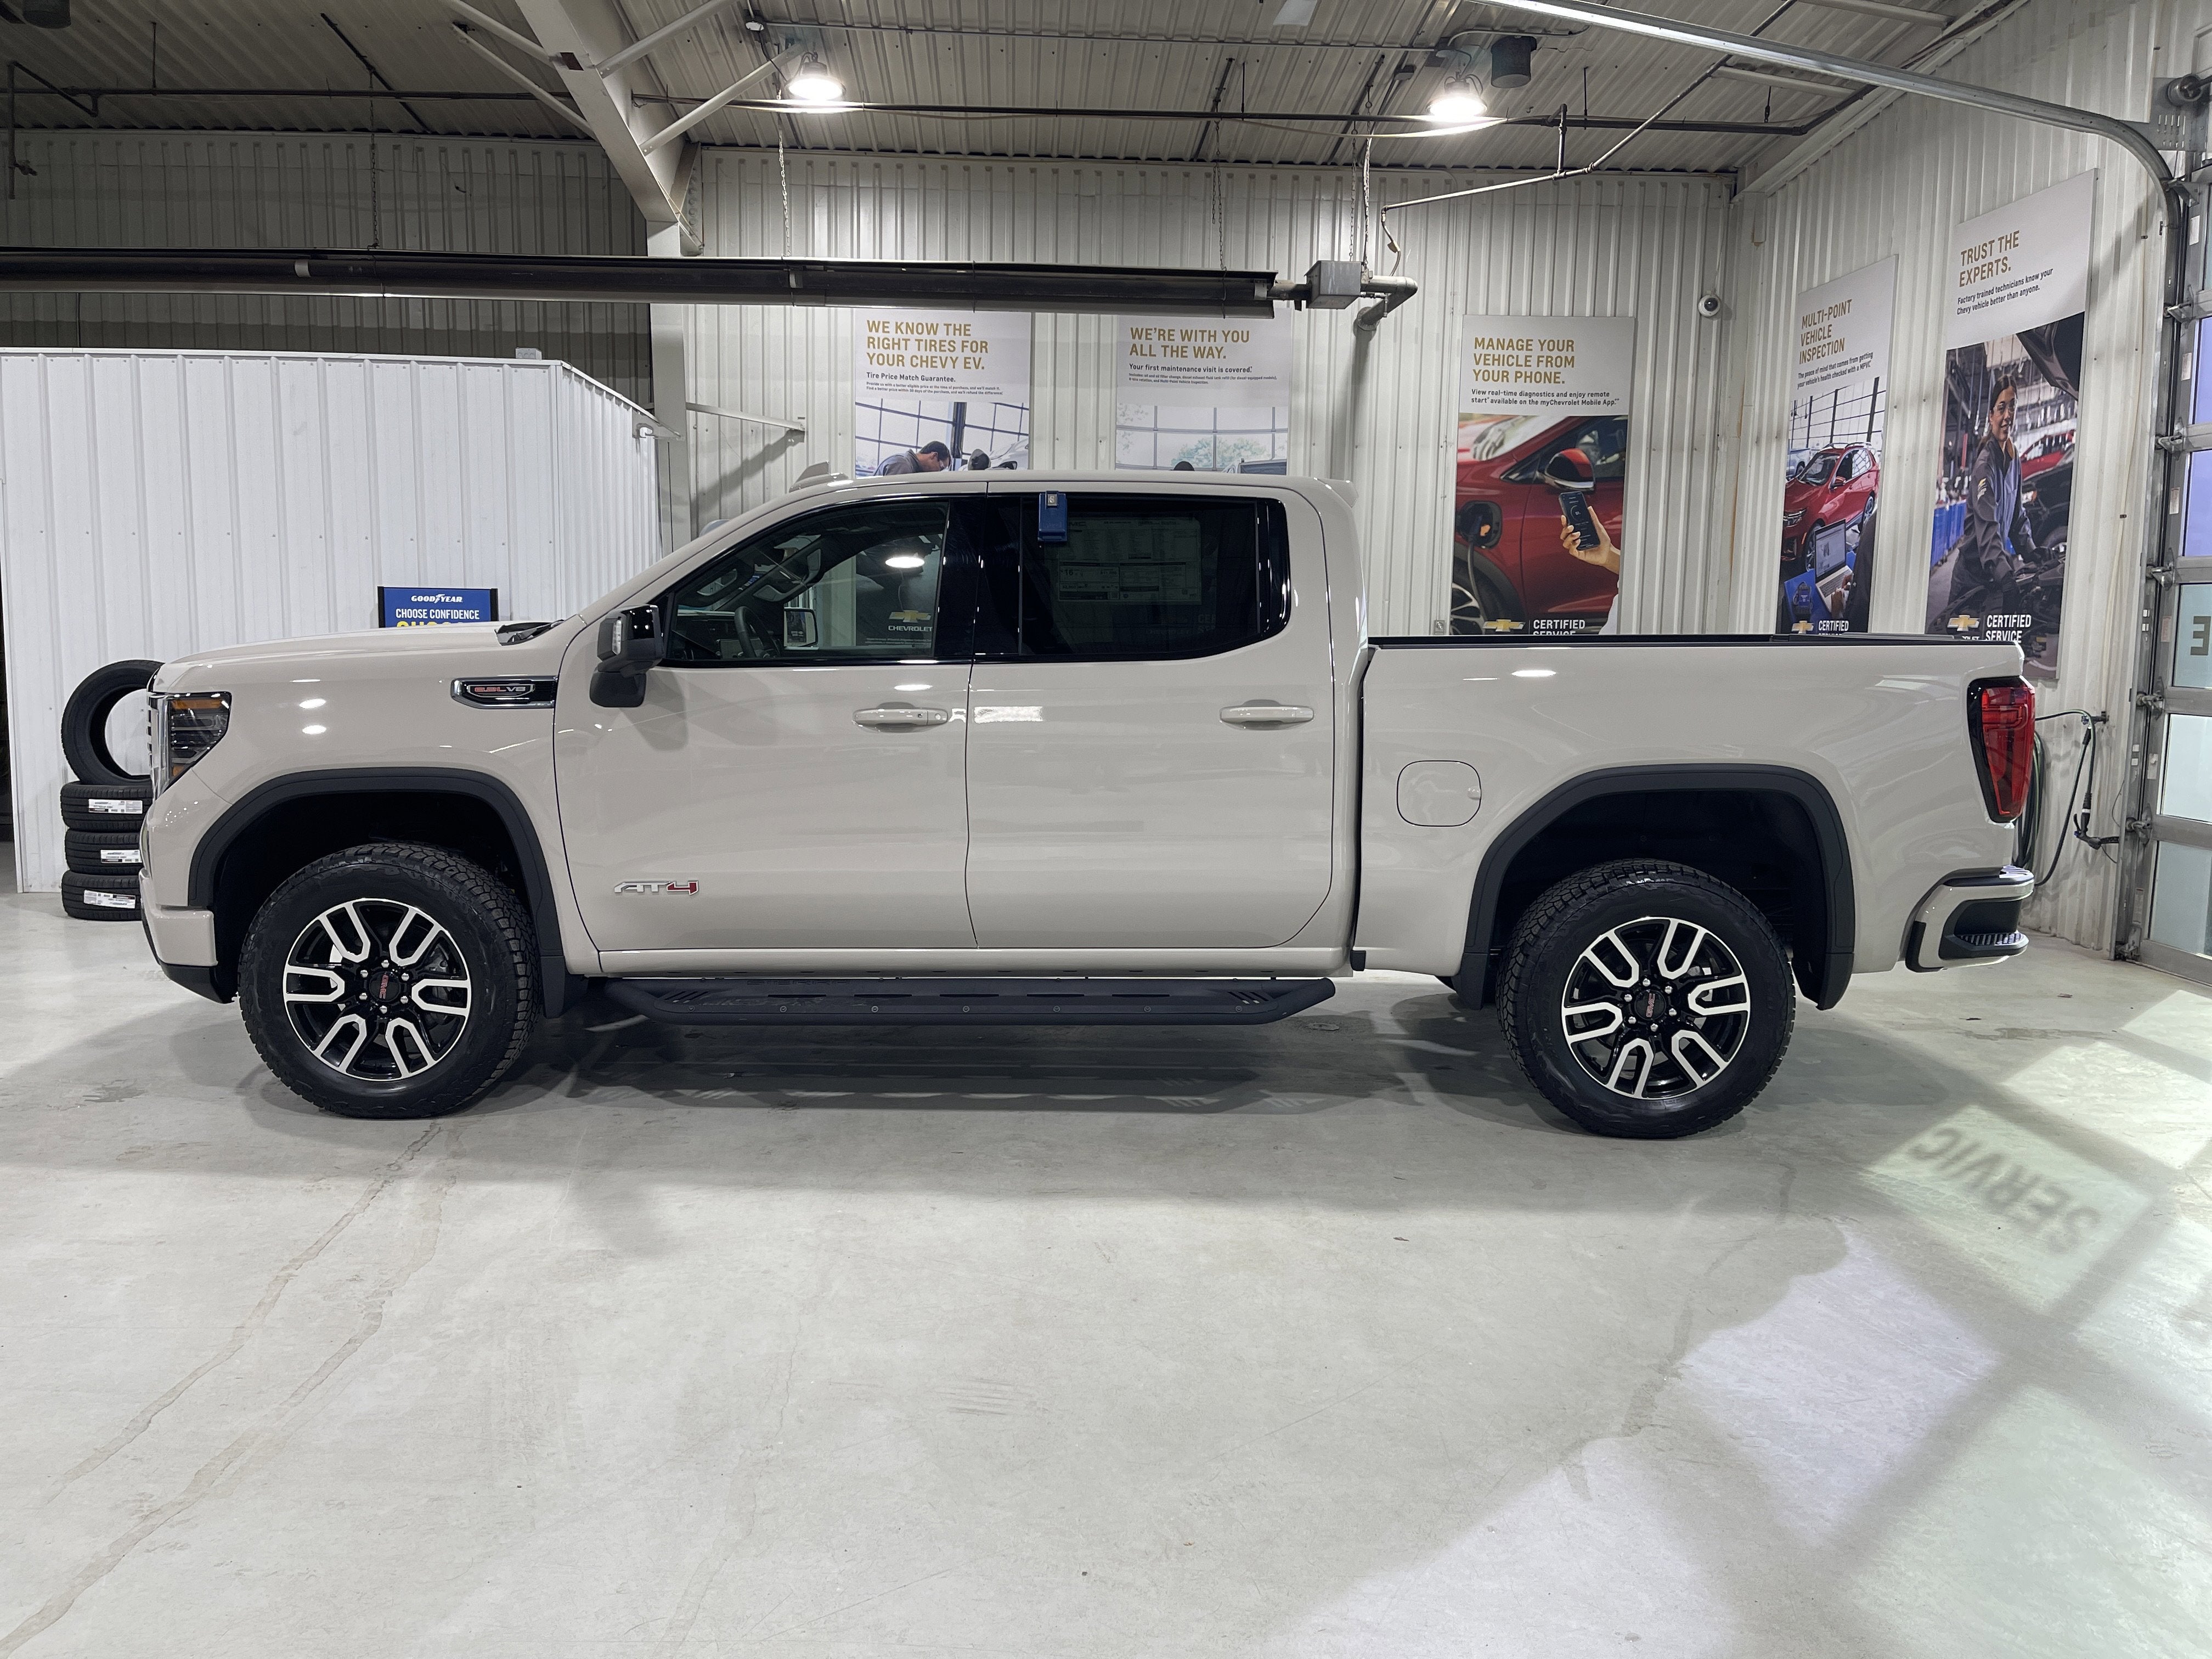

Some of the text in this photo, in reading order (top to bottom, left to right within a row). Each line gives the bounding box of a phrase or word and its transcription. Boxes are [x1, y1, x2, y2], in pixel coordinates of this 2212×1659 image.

[1961, 230, 2019, 266] TRUST THE
[1960, 256, 2011, 287] EXPERTS.
[1958, 269, 2053, 304] Factory trained technicians know your
[1957, 285, 2040, 315] Chevy vehicle better than anyone.
[1802, 299, 1852, 329] MULTI-POINT
[867, 320, 971, 336] WE KNOW THE
[1131, 328, 1250, 343] WE'RE WITH YOU
[1801, 324, 1832, 346] VEHICLE
[867, 337, 988, 353] RIGHT TIRES FOR
[1130, 343, 1226, 359] ALL THE WAY.
[1475, 337, 1575, 352] MANAGE YOUR
[1799, 337, 1845, 364] INSPECTION
[867, 353, 985, 370] YOUR CHEVY EV.
[1474, 353, 1575, 368] VEHICLE FROM
[1472, 369, 1565, 384] YOUR PHONE.
[411, 594, 463, 603] GOODYEAR
[396, 608, 479, 619] CHOOSE CONFIDENCE
[1987, 614, 2032, 628] CERTIFIED
[1533, 619, 1585, 629] CERTIFIED
[1818, 620, 1849, 631] CERTIFIED
[1985, 630, 2022, 643] SERVICE
[614, 881, 698, 895] AT4
[379, 975, 388, 999] GMC
[1646, 993, 1655, 1018] GMC
